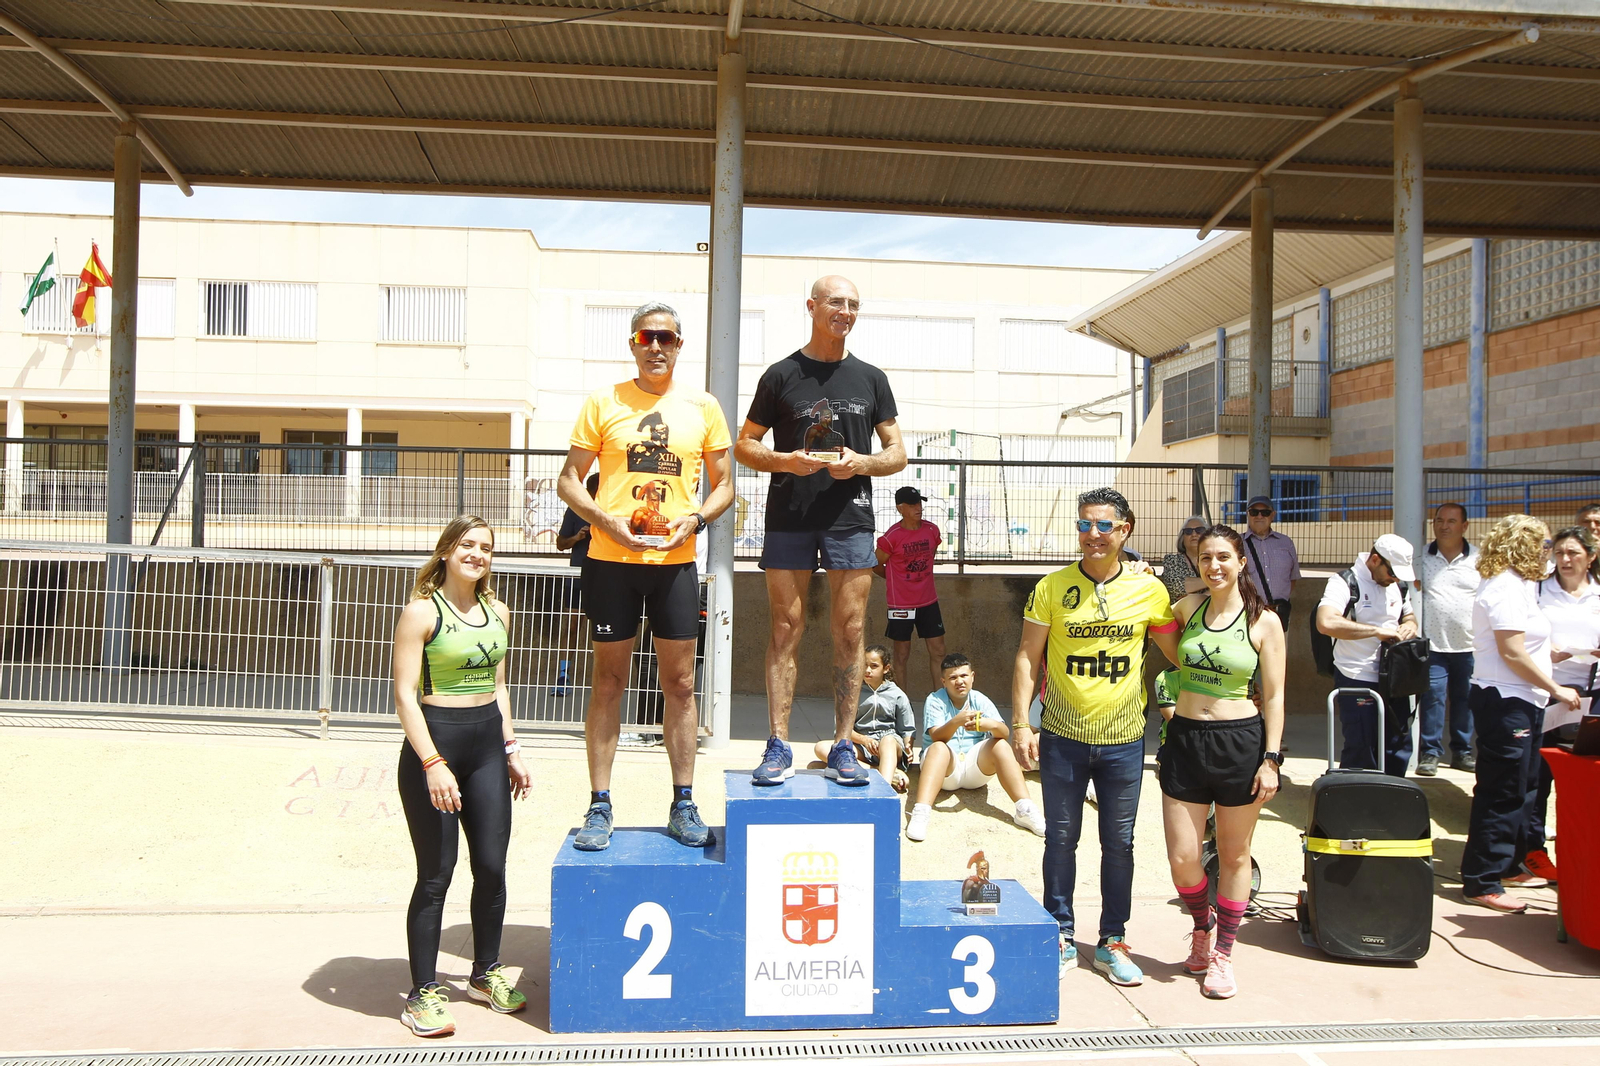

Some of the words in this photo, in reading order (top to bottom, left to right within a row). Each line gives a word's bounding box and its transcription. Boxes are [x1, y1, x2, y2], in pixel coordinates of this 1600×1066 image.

[658, 452, 678, 462] XIII
[1067, 624, 1134, 638] SPORTGYM
[1065, 650, 1130, 684] mtp
[622, 901, 673, 1000] 2
[754, 955, 865, 981] ALMERÍA
[948, 935, 996, 1015] 3
[781, 983, 838, 997] CIUDAD
